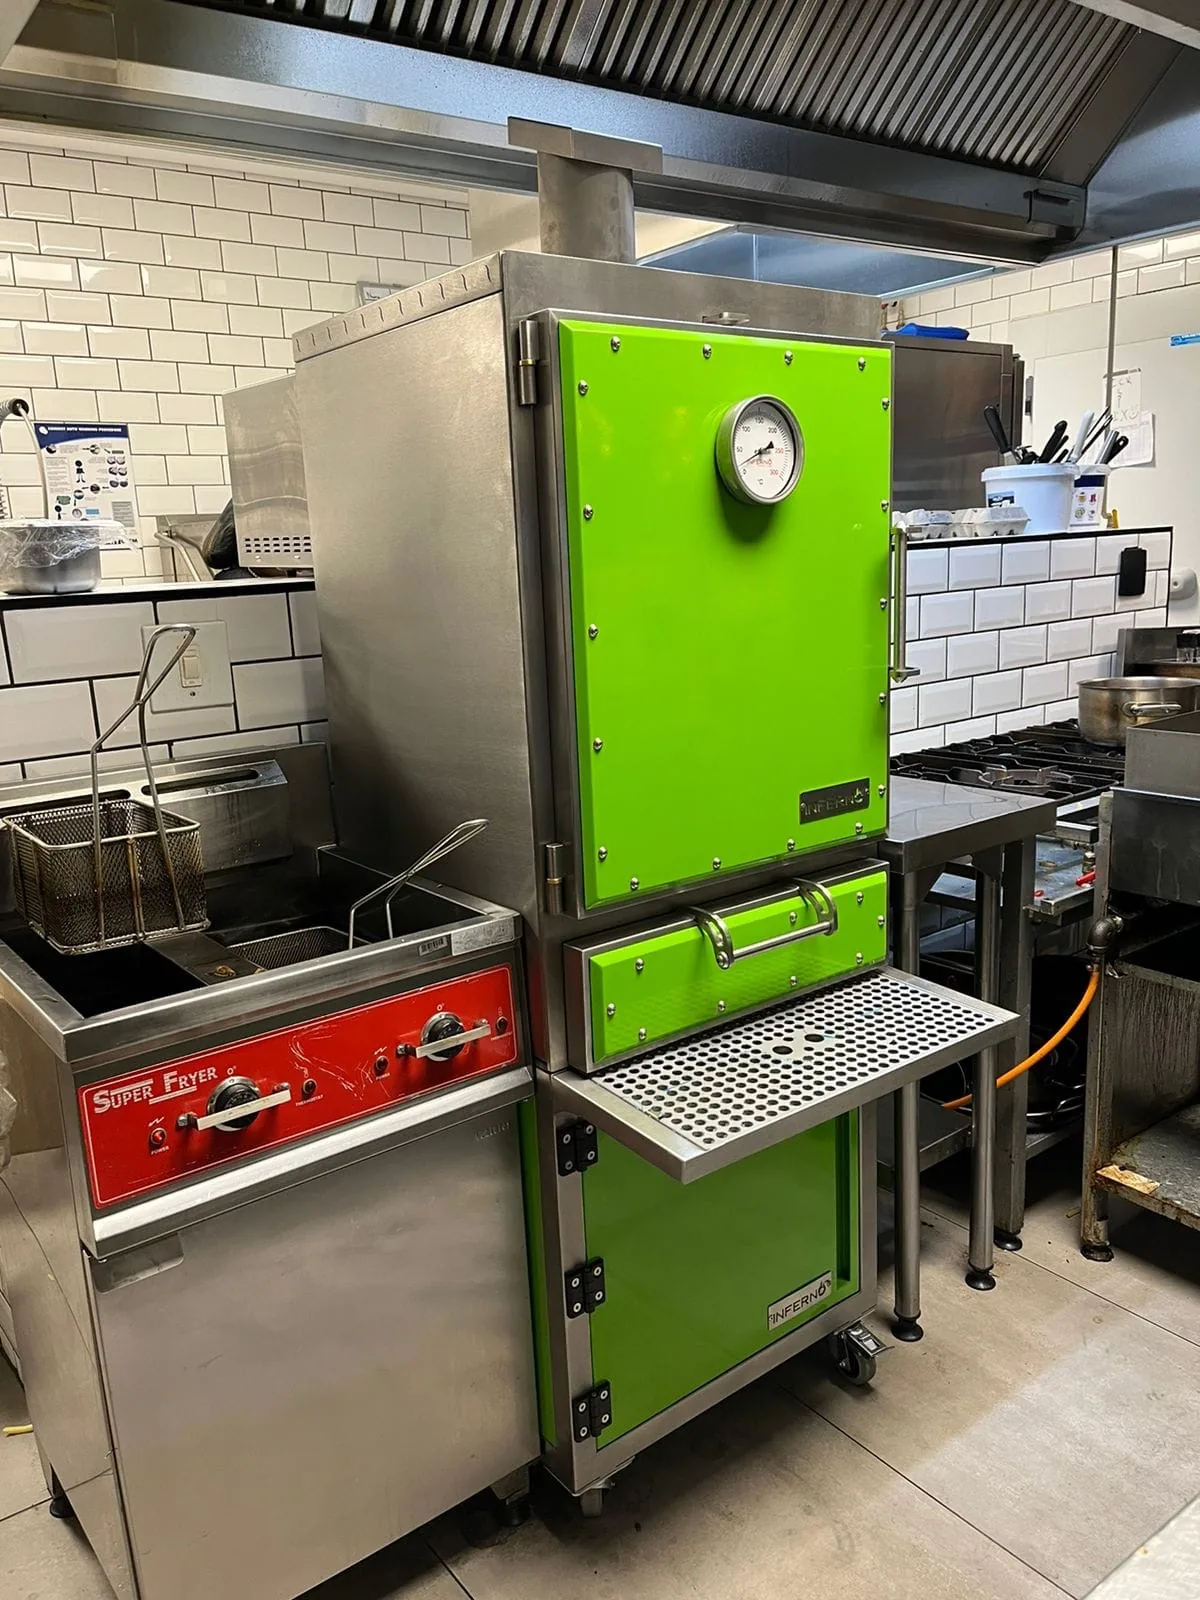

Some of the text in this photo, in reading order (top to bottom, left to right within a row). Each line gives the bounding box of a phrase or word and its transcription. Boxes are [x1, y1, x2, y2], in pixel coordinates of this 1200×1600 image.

[93, 1066, 218, 1114] SUPER FRYER
[772, 1281, 828, 1325] INFERNO
